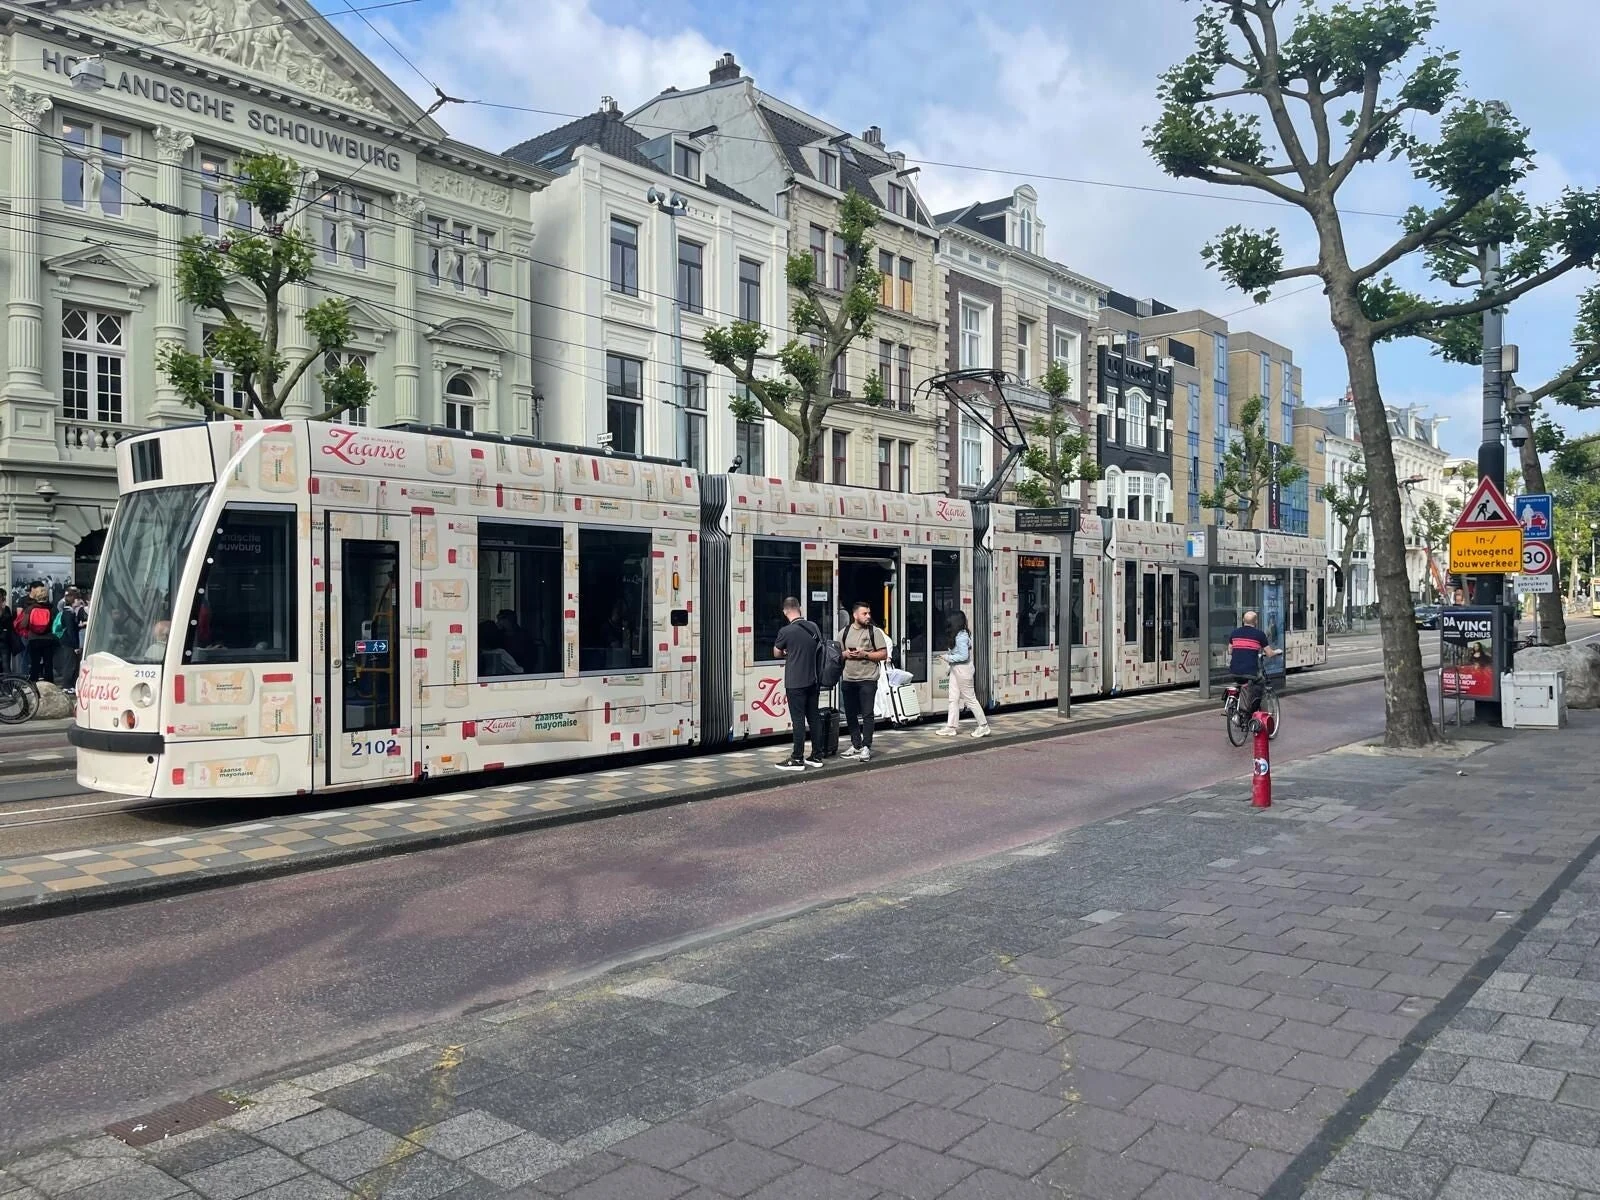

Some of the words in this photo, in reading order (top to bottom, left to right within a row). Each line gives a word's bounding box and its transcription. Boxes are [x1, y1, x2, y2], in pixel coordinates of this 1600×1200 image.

[42, 48, 235, 123] HOANDSCHE
[247, 109, 400, 172] SCHOUWBURG
[322, 428, 407, 466] Zaanse
[1457, 547, 1514, 558] uitvoegend
[1523, 551, 1546, 564] 30
[1453, 560, 1519, 569] bouwverkeer
[1443, 616, 1456, 627] DA
[1456, 620, 1492, 631] VINCI
[134, 670, 157, 679] 2102
[535, 718, 578, 731] mayonaise
[351, 739, 397, 756] 2102
